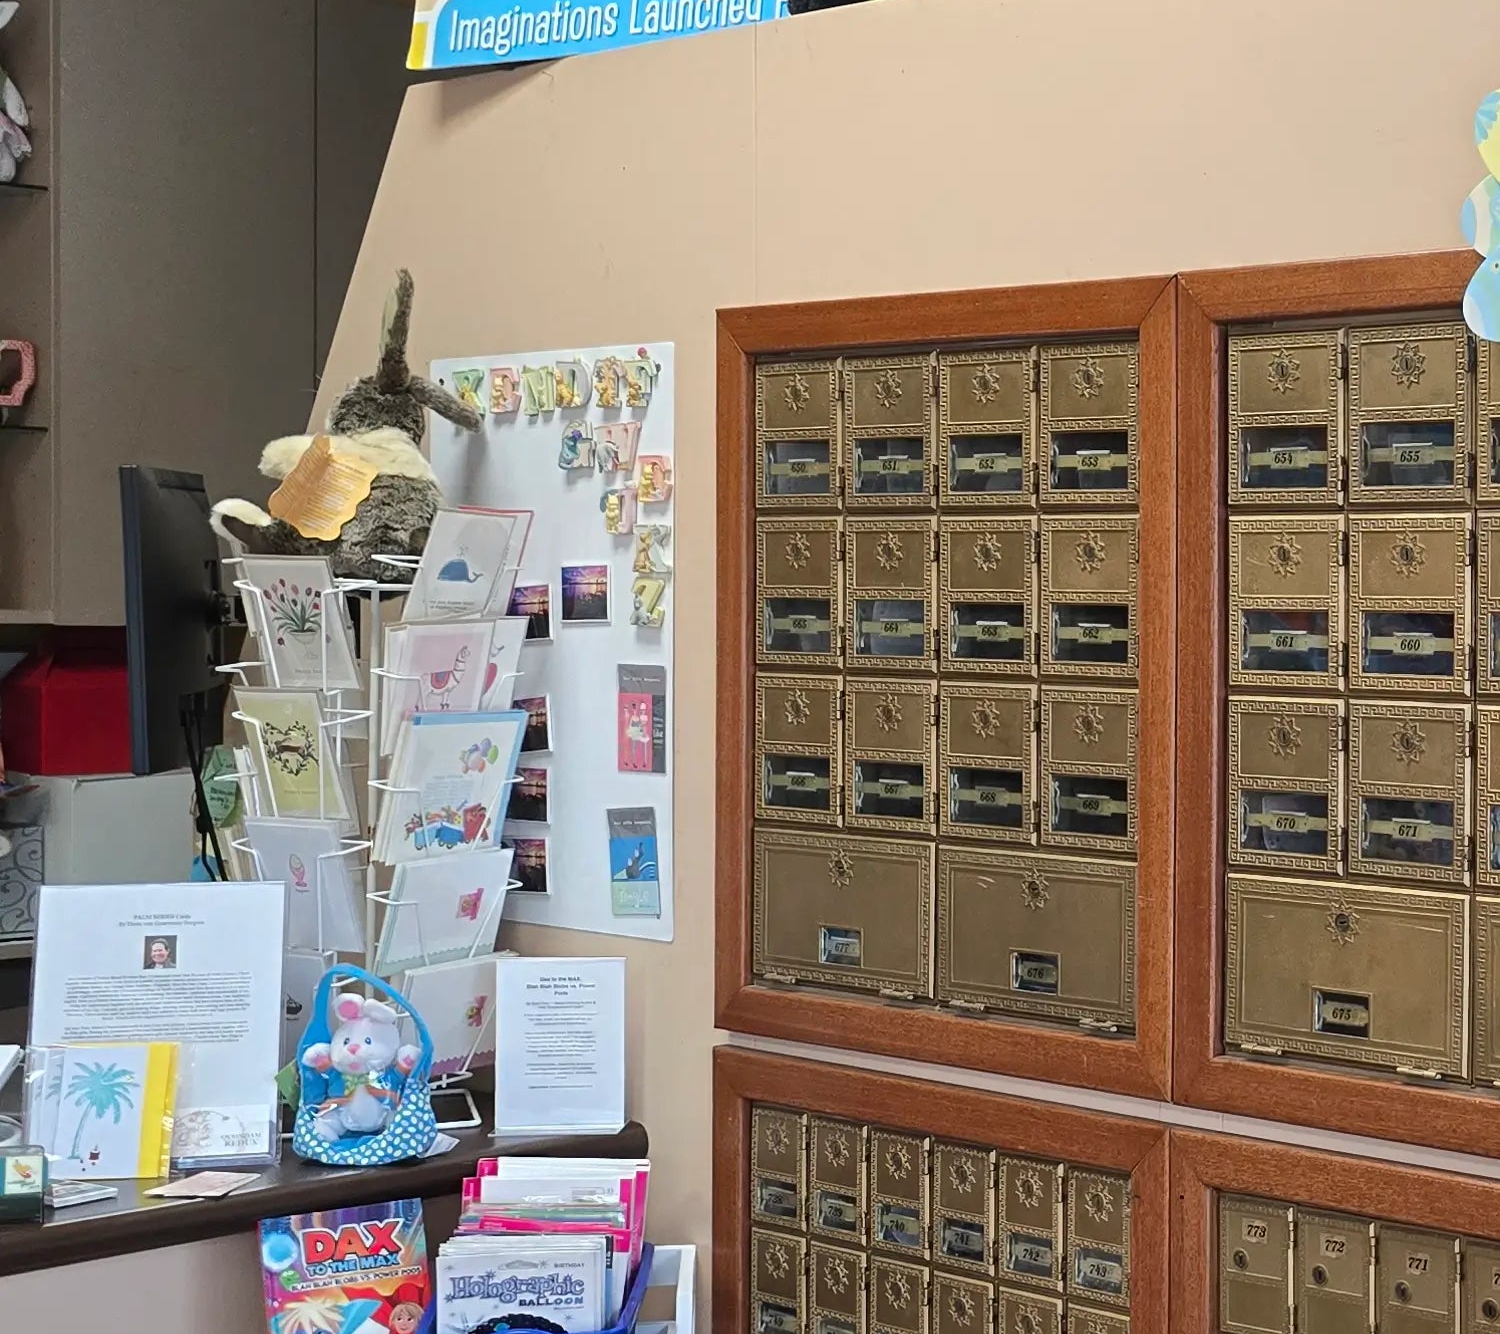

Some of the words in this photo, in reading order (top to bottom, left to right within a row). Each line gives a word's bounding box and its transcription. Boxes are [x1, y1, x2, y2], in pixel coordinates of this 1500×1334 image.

[1274, 451, 1293, 466] 654
[1400, 450, 1421, 464] 655
[1275, 635, 1294, 649] 661
[1400, 638, 1421, 652] 660
[1275, 816, 1296, 830] 670
[1398, 823, 1418, 837] 671
[1331, 1006, 1352, 1022] 675
[1246, 1225, 1266, 1238] 773
[303, 1220, 400, 1263] DAX
[1325, 1239, 1346, 1253] 772
[306, 1265, 327, 1278] TO
[331, 1259, 357, 1274] THE
[360, 1253, 400, 1271] MAX
[1408, 1256, 1428, 1271] 771
[449, 1273, 585, 1304] Holographic
[519, 1296, 584, 1308] BALLOON
